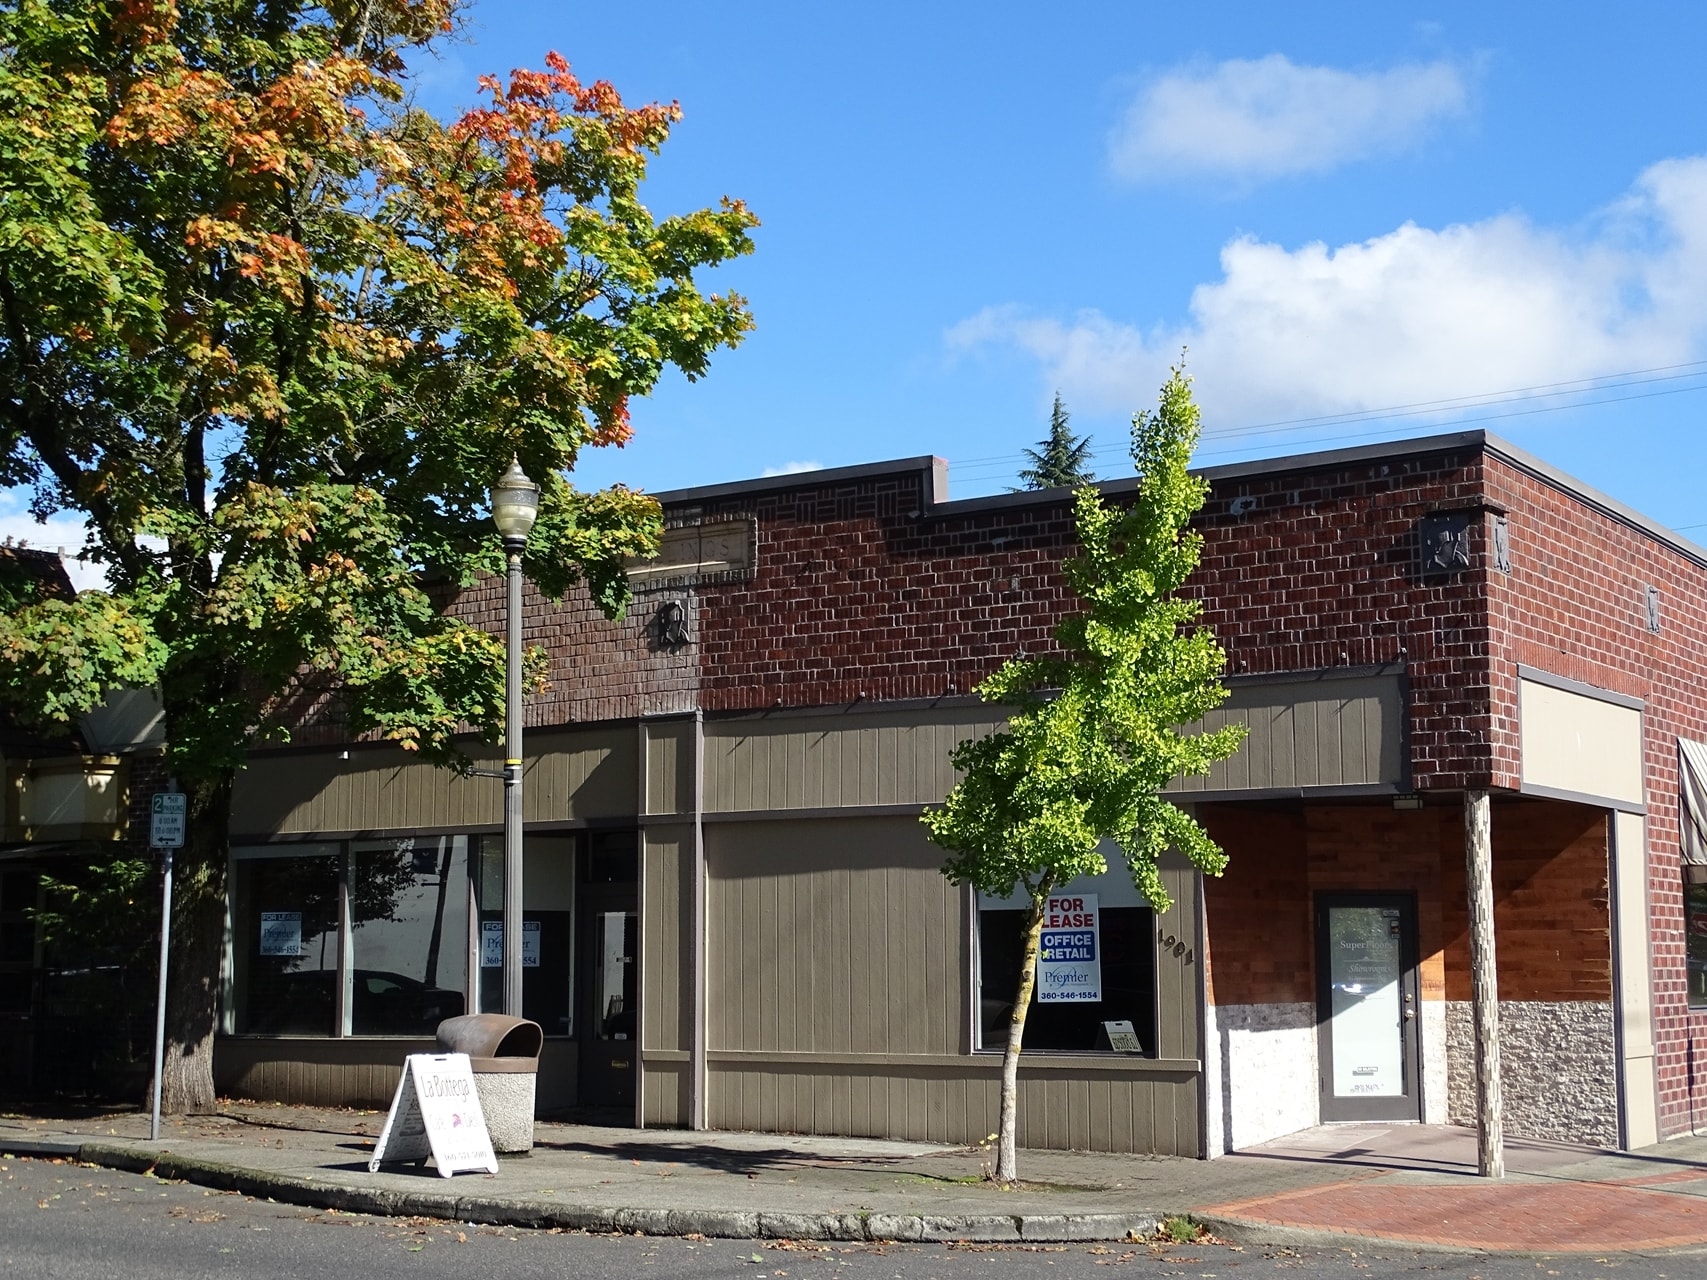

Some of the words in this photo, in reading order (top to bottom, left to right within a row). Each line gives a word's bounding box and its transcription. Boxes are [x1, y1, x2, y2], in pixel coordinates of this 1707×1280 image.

[154, 797, 162, 811] 2
[1049, 898, 1084, 912] FOR
[1044, 934, 1092, 947] OFFICE
[1158, 928, 1194, 966] 1901
[1047, 948, 1091, 960] RETAIL
[1045, 971, 1088, 983] Premier
[1041, 992, 1098, 1000] 360-546-1554
[421, 1075, 435, 1098] La
[433, 1075, 470, 1103] Bottega
